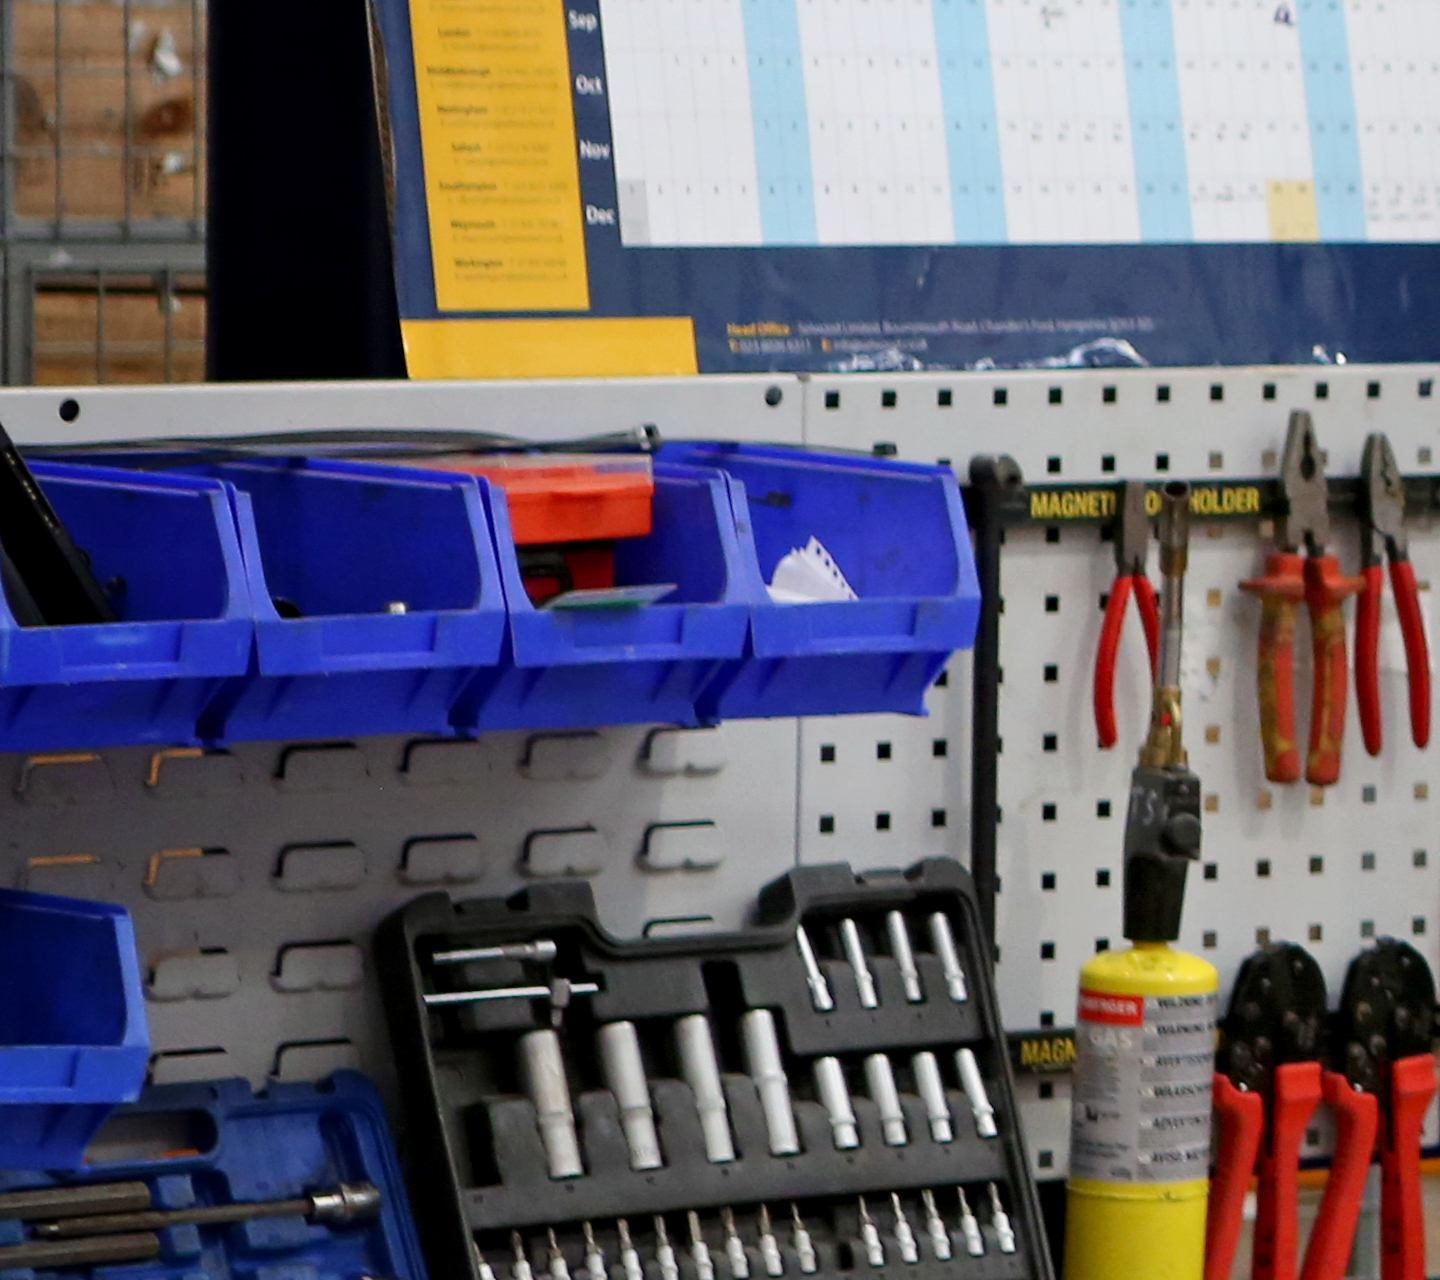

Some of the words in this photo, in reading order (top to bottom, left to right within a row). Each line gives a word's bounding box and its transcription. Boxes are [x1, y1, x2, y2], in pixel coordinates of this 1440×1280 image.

[568, 10, 598, 32] Sep
[575, 74, 602, 94] Oct
[579, 140, 610, 158] Nov
[586, 205, 615, 224] Dec
[1031, 489, 1117, 519] MAGNETI
[1021, 1038, 1077, 1065] MAGN
